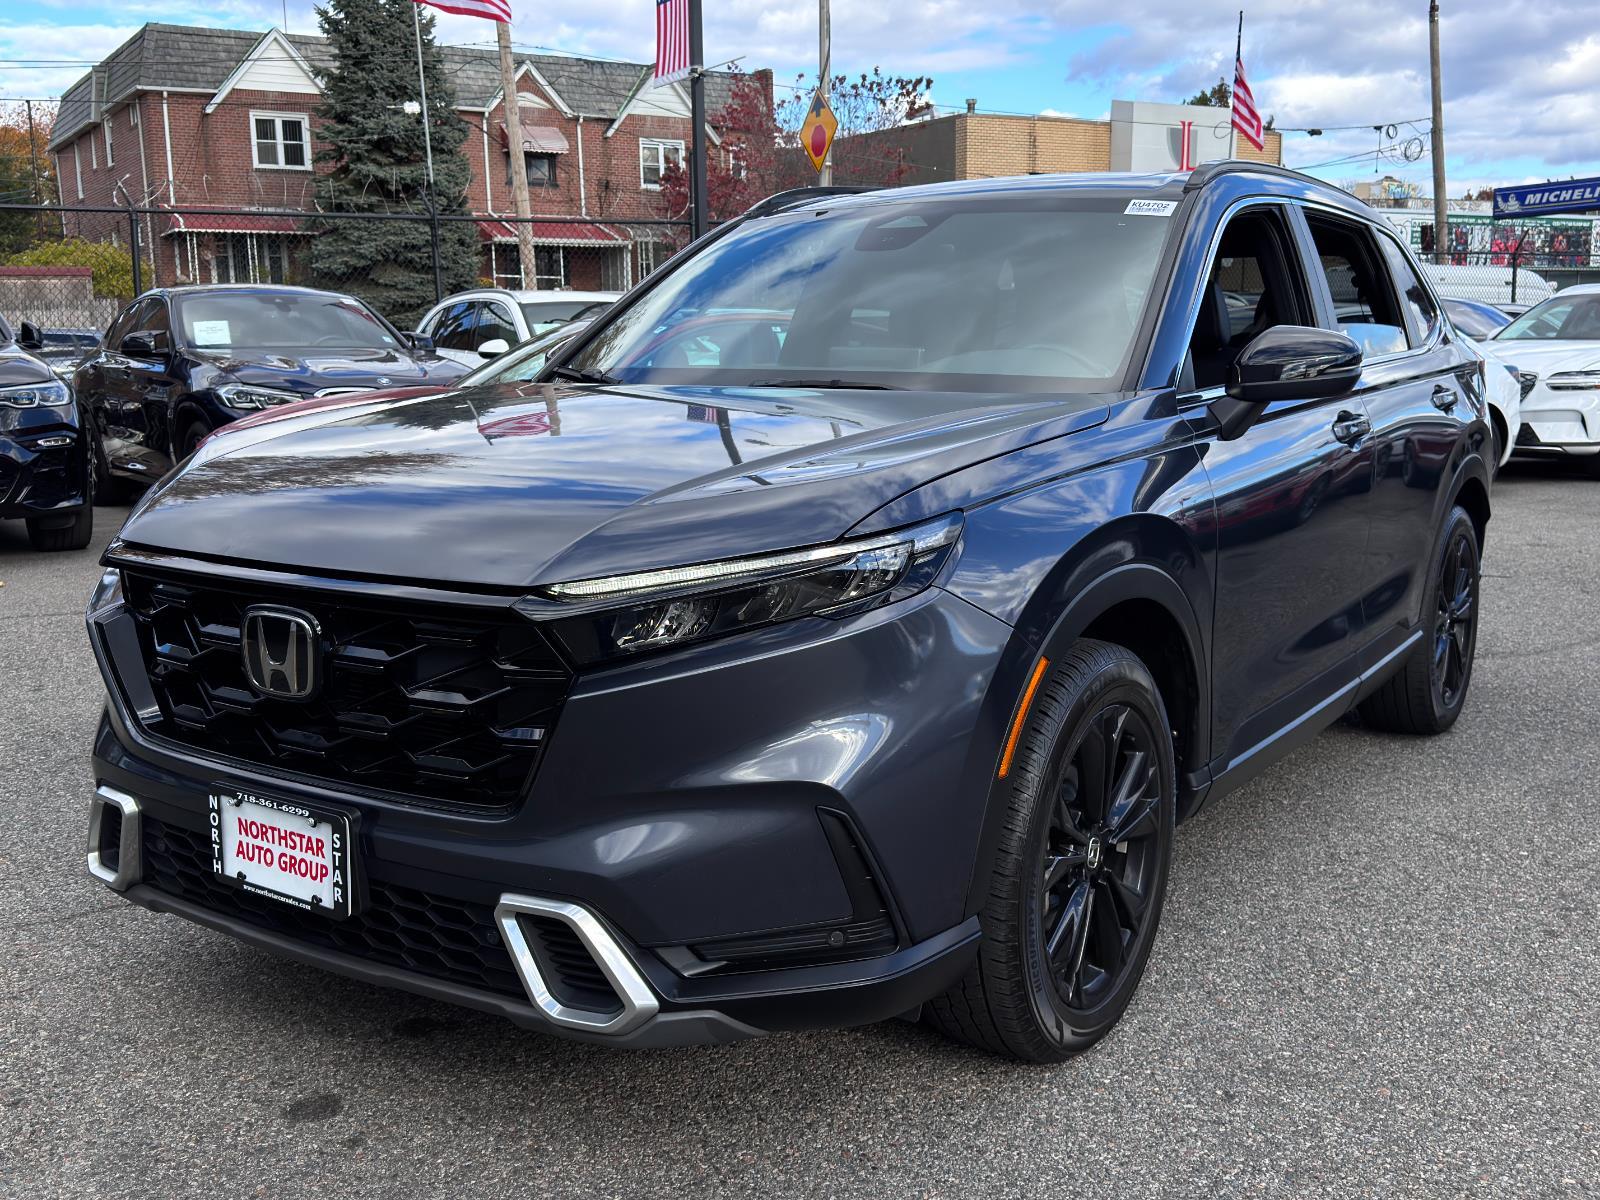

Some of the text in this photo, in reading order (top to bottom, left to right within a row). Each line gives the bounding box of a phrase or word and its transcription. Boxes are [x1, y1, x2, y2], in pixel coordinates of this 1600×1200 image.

[1132, 201, 1170, 209] KU4702
[1525, 187, 1600, 205] MICHELI
[236, 792, 310, 817] 718-361-6299
[208, 794, 222, 875] NORTH
[237, 816, 326, 859] NORTHSTAR
[235, 840, 329, 883] AUTO GROUP
[332, 833, 343, 903] STAR
